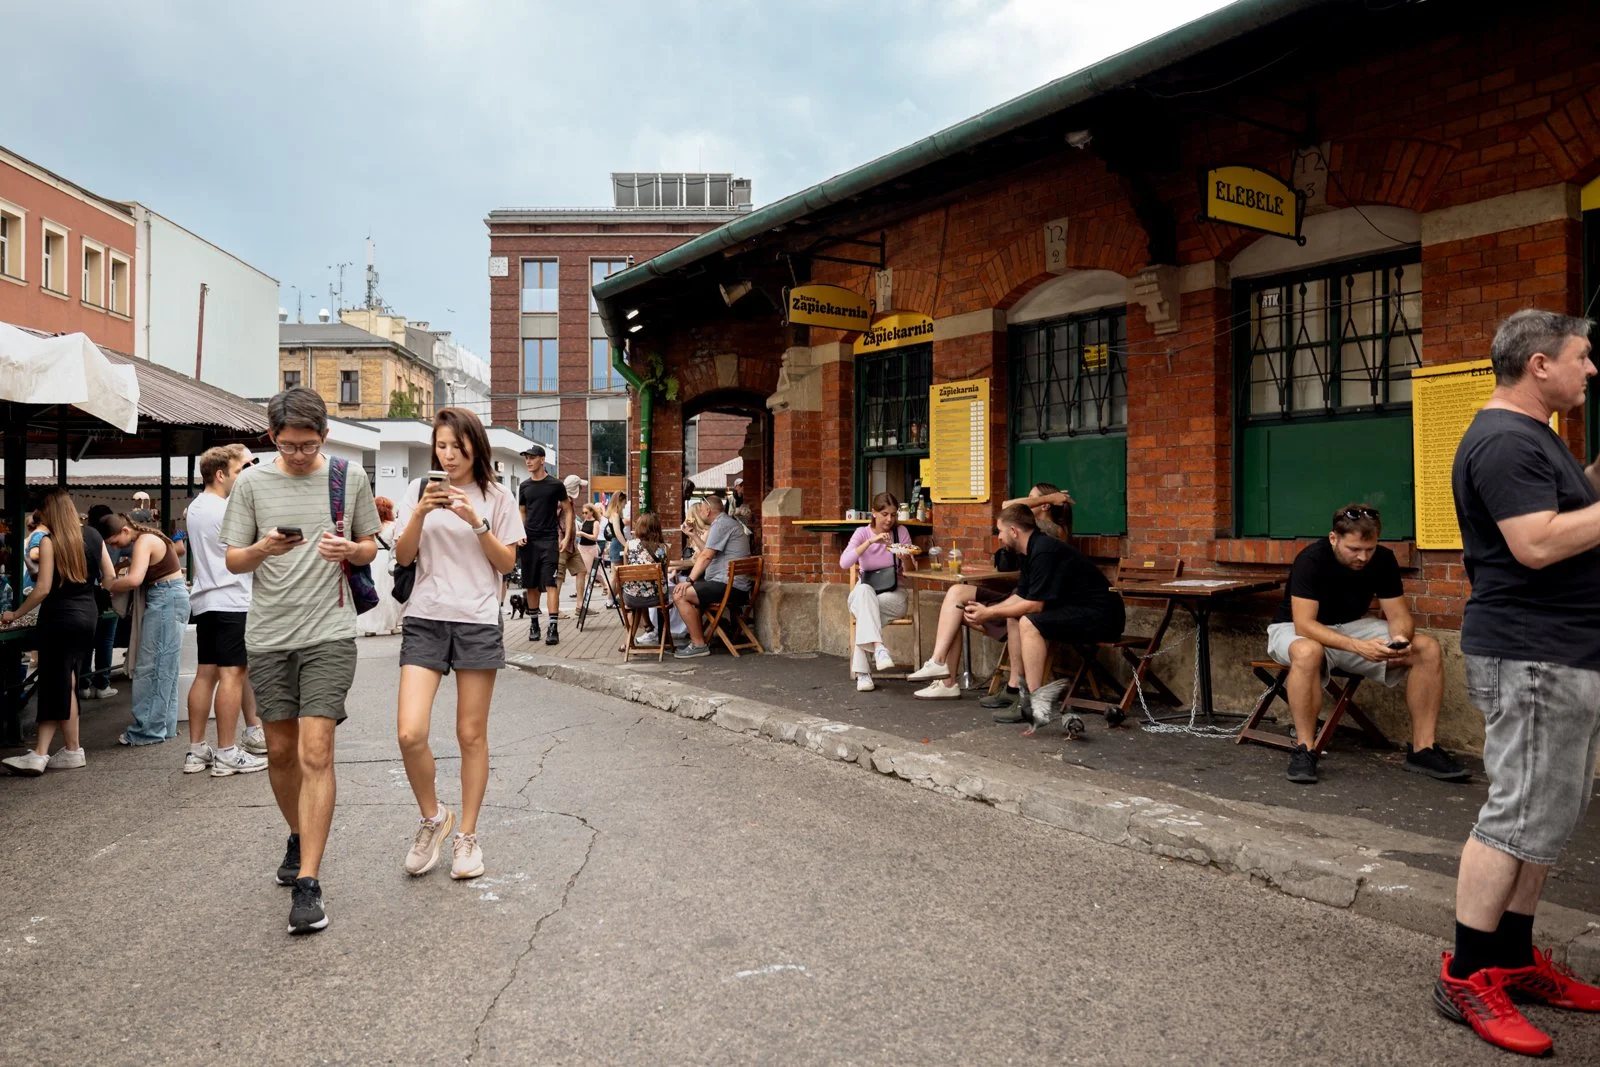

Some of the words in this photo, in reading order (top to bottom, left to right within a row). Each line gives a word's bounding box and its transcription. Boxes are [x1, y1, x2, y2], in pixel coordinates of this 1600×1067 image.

[1296, 151, 1325, 174] 12
[1215, 180, 1284, 216] ELEBELE
[1046, 225, 1065, 243] 12
[792, 297, 868, 319] Zapiekarnia
[863, 319, 934, 346] Zapiekarnia
[939, 384, 979, 397] Zapiekarnia
